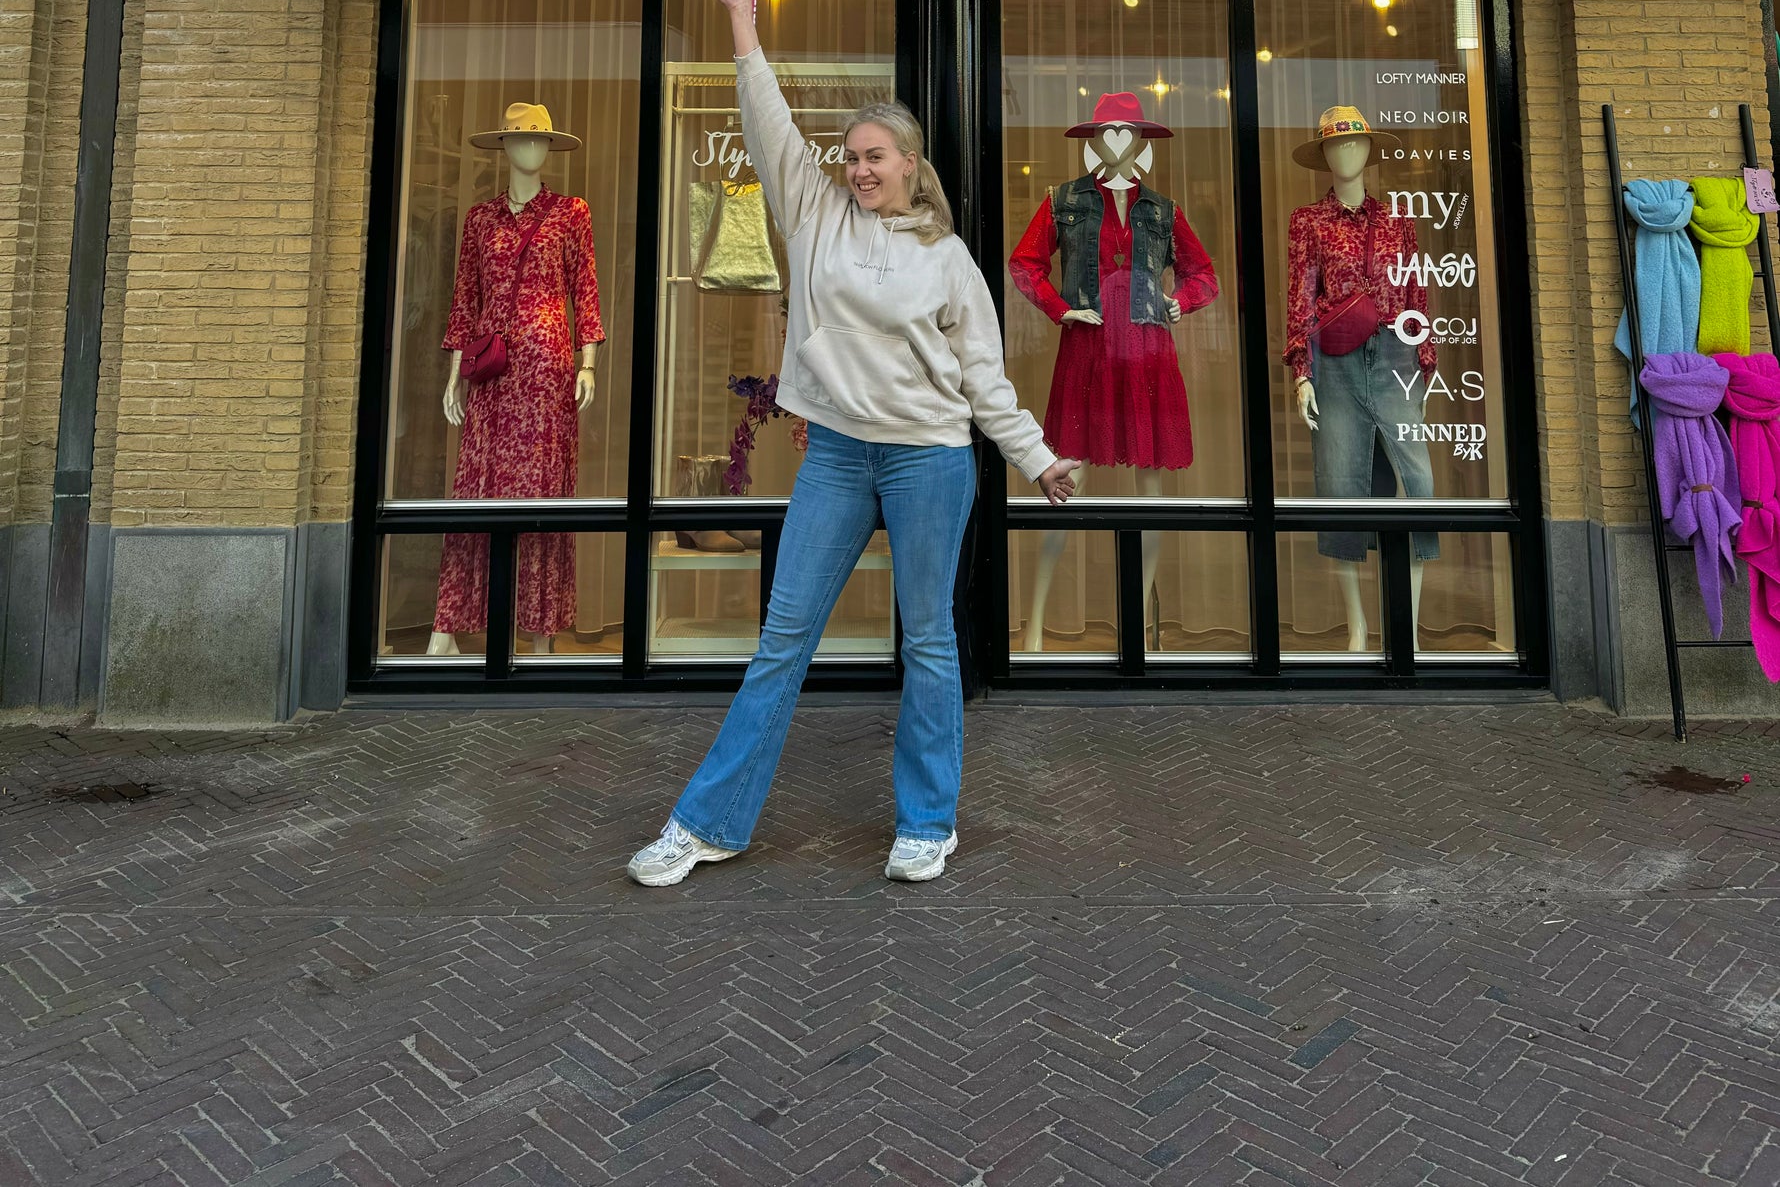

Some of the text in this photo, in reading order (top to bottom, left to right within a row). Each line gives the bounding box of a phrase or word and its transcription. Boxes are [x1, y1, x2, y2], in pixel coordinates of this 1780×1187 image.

[1376, 72, 1466, 85] LOFTY MANNER
[1379, 110, 1469, 124] NEO NOIR
[1381, 148, 1471, 161] LOAVIES
[1387, 189, 1460, 230] my
[1453, 192, 1470, 230] JEWELLERY
[1432, 317, 1477, 336] COJ
[1430, 336, 1446, 344] CUP
[1461, 337, 1477, 345] JOE
